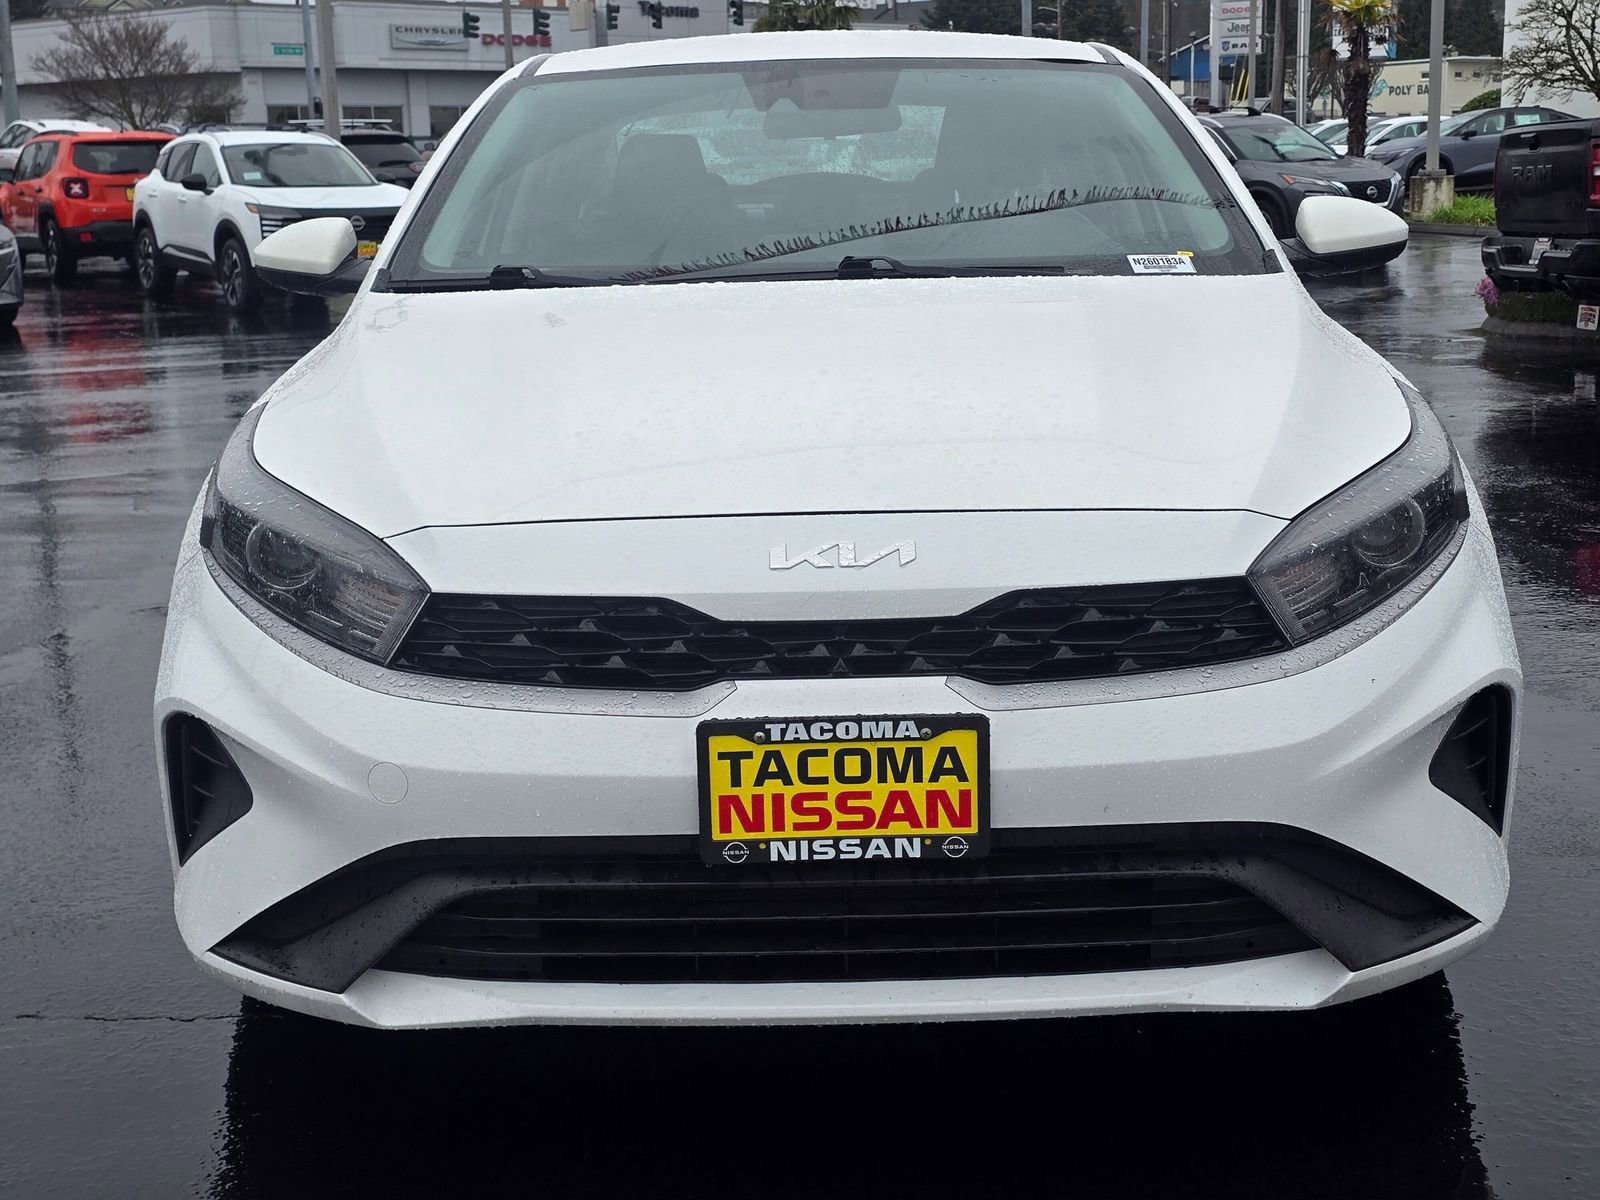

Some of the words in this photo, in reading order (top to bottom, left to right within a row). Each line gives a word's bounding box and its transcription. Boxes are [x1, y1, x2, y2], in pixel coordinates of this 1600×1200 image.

[638, 1, 700, 18] Toma
[1222, 6, 1256, 14] DODG
[481, 33, 553, 48] DODGE
[1389, 85, 1412, 96] POLY
[1511, 165, 1553, 185] RAM
[1132, 257, 1186, 266] N260183A
[768, 539, 917, 571] KIA
[765, 720, 920, 742] TACOMA
[717, 746, 969, 788] TACOMA
[717, 788, 972, 834] NISSAN
[769, 838, 922, 862] NISSAN
